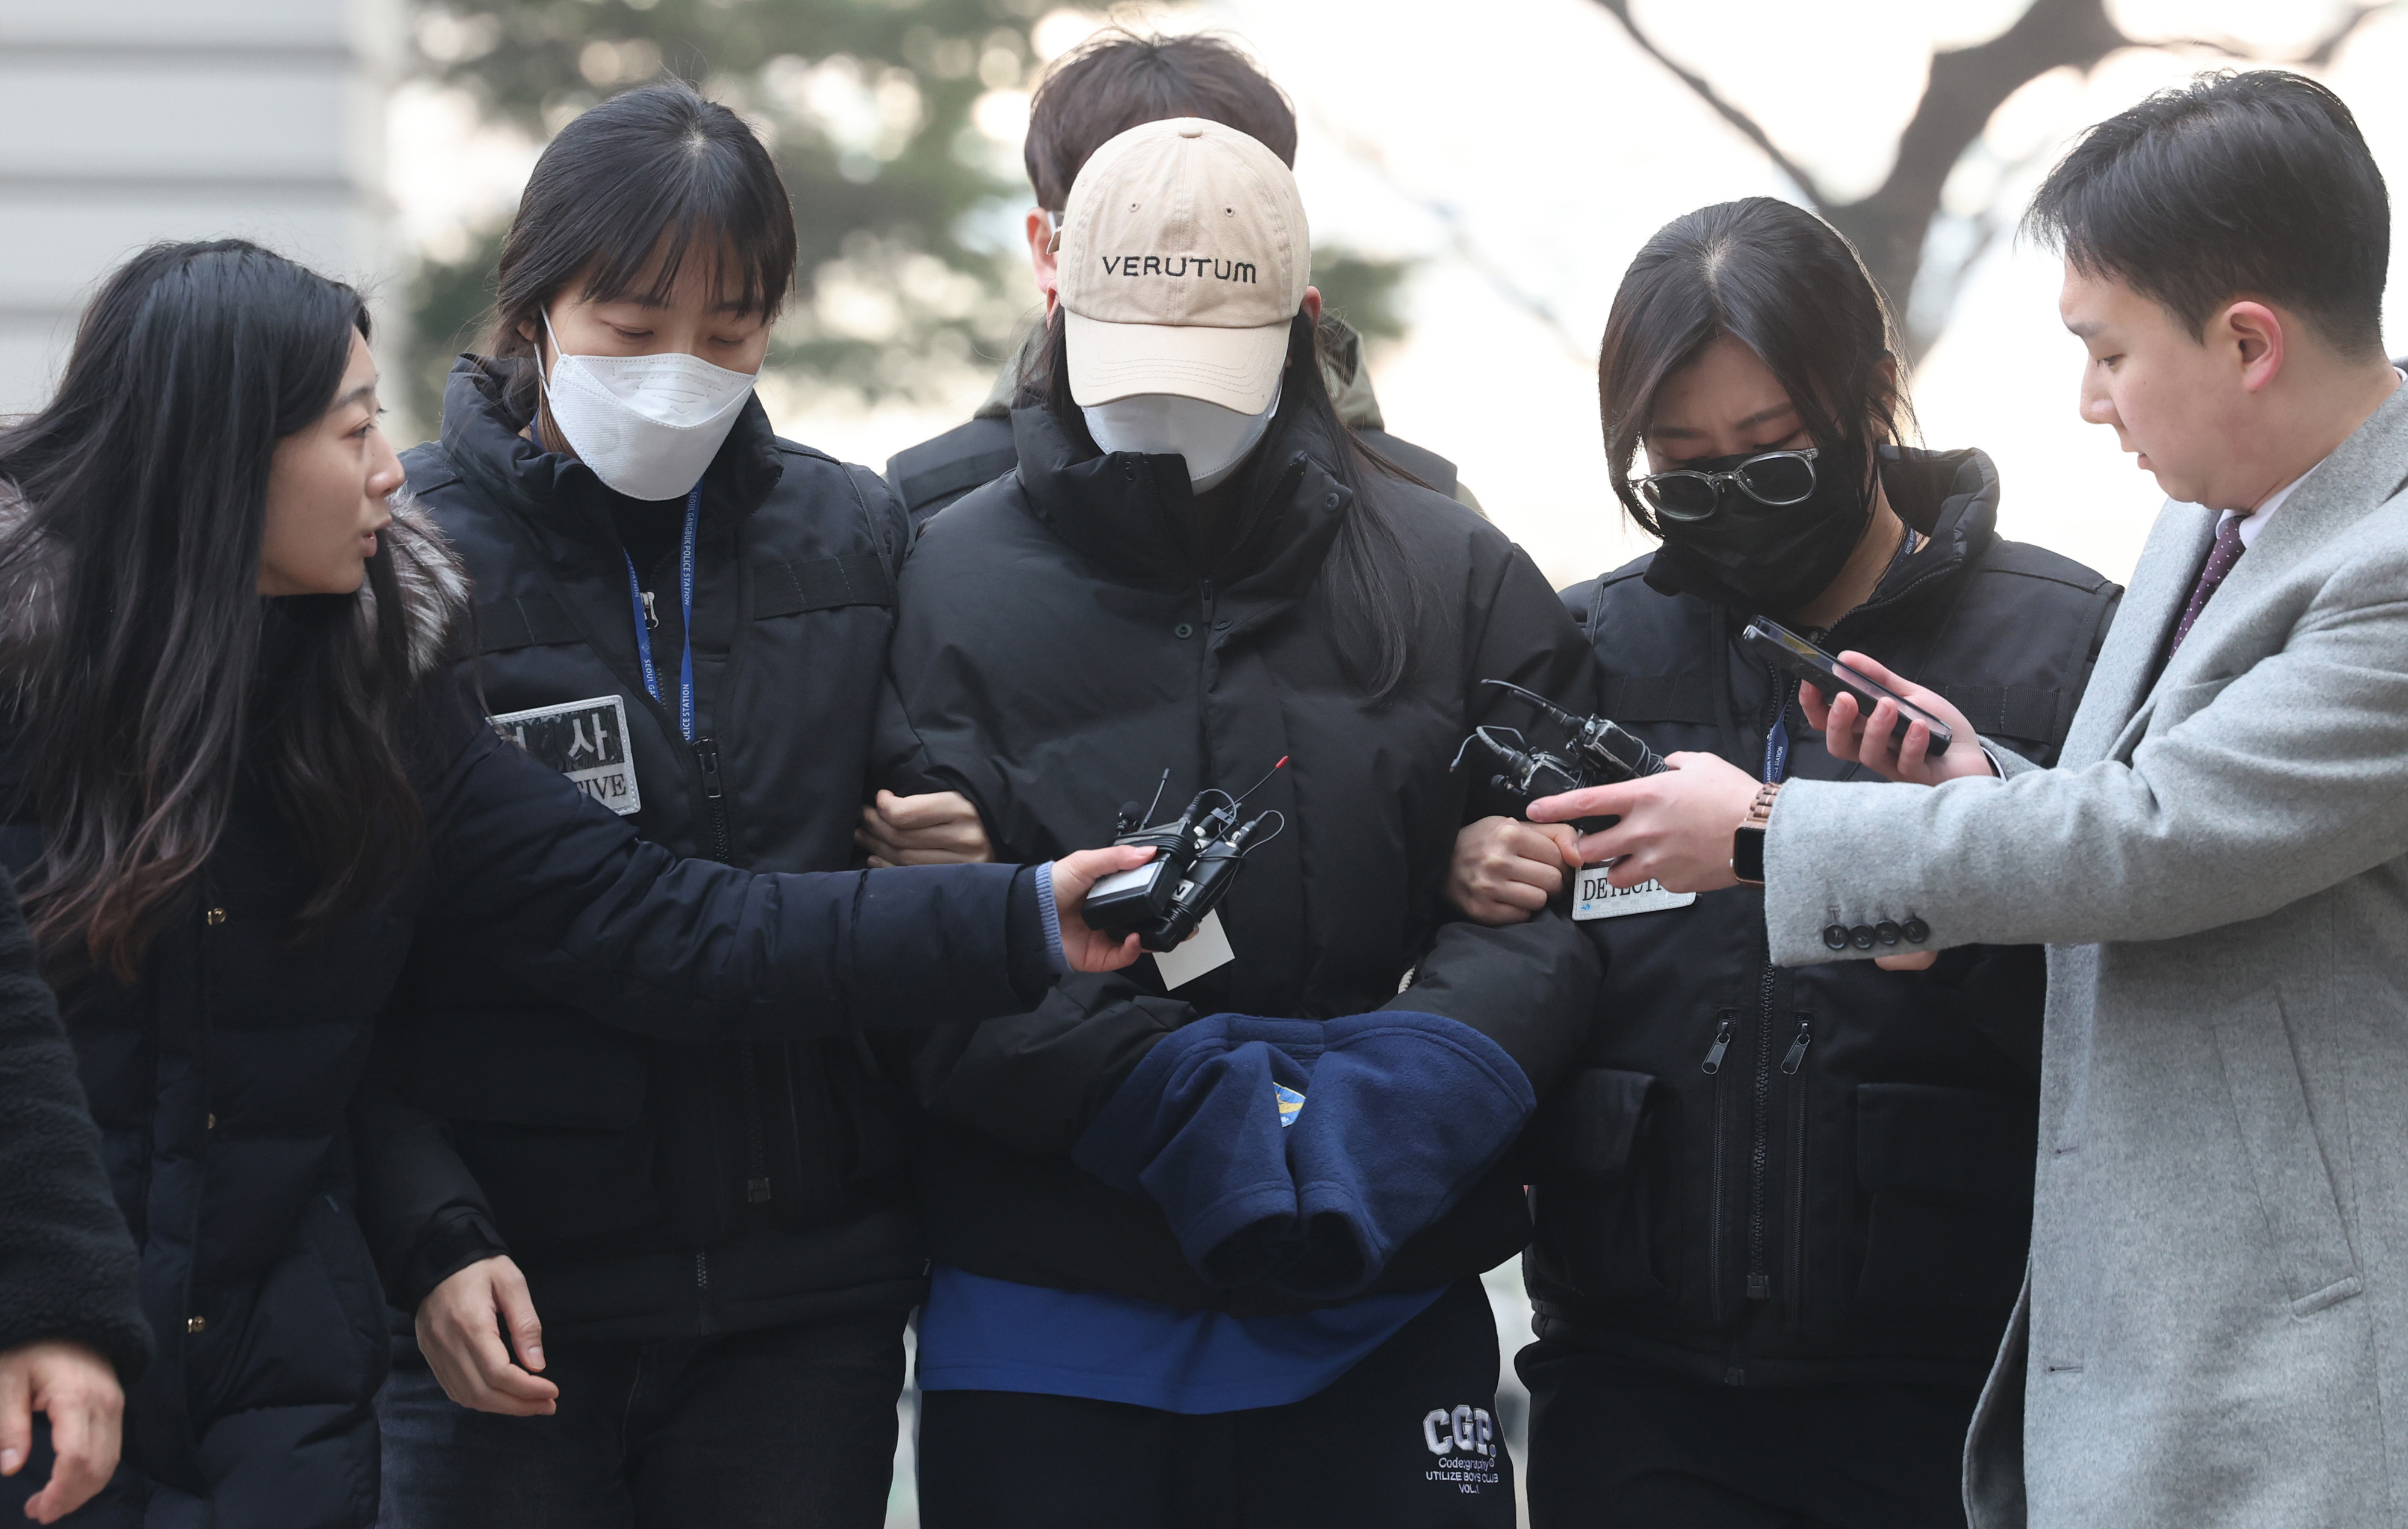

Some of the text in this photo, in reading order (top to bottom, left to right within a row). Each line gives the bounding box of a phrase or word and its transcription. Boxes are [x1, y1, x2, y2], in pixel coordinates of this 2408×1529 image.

[687, 491, 697, 511] SEOUL
[684, 513, 694, 545] GANGBUK
[683, 545, 691, 572] POLICE
[644, 659, 654, 683] SEOUL
[682, 718, 690, 740] OLICE
[1774, 746, 1783, 766] STATION
[1426, 1471, 1499, 1483] UTILIZE BOYS CLUB
